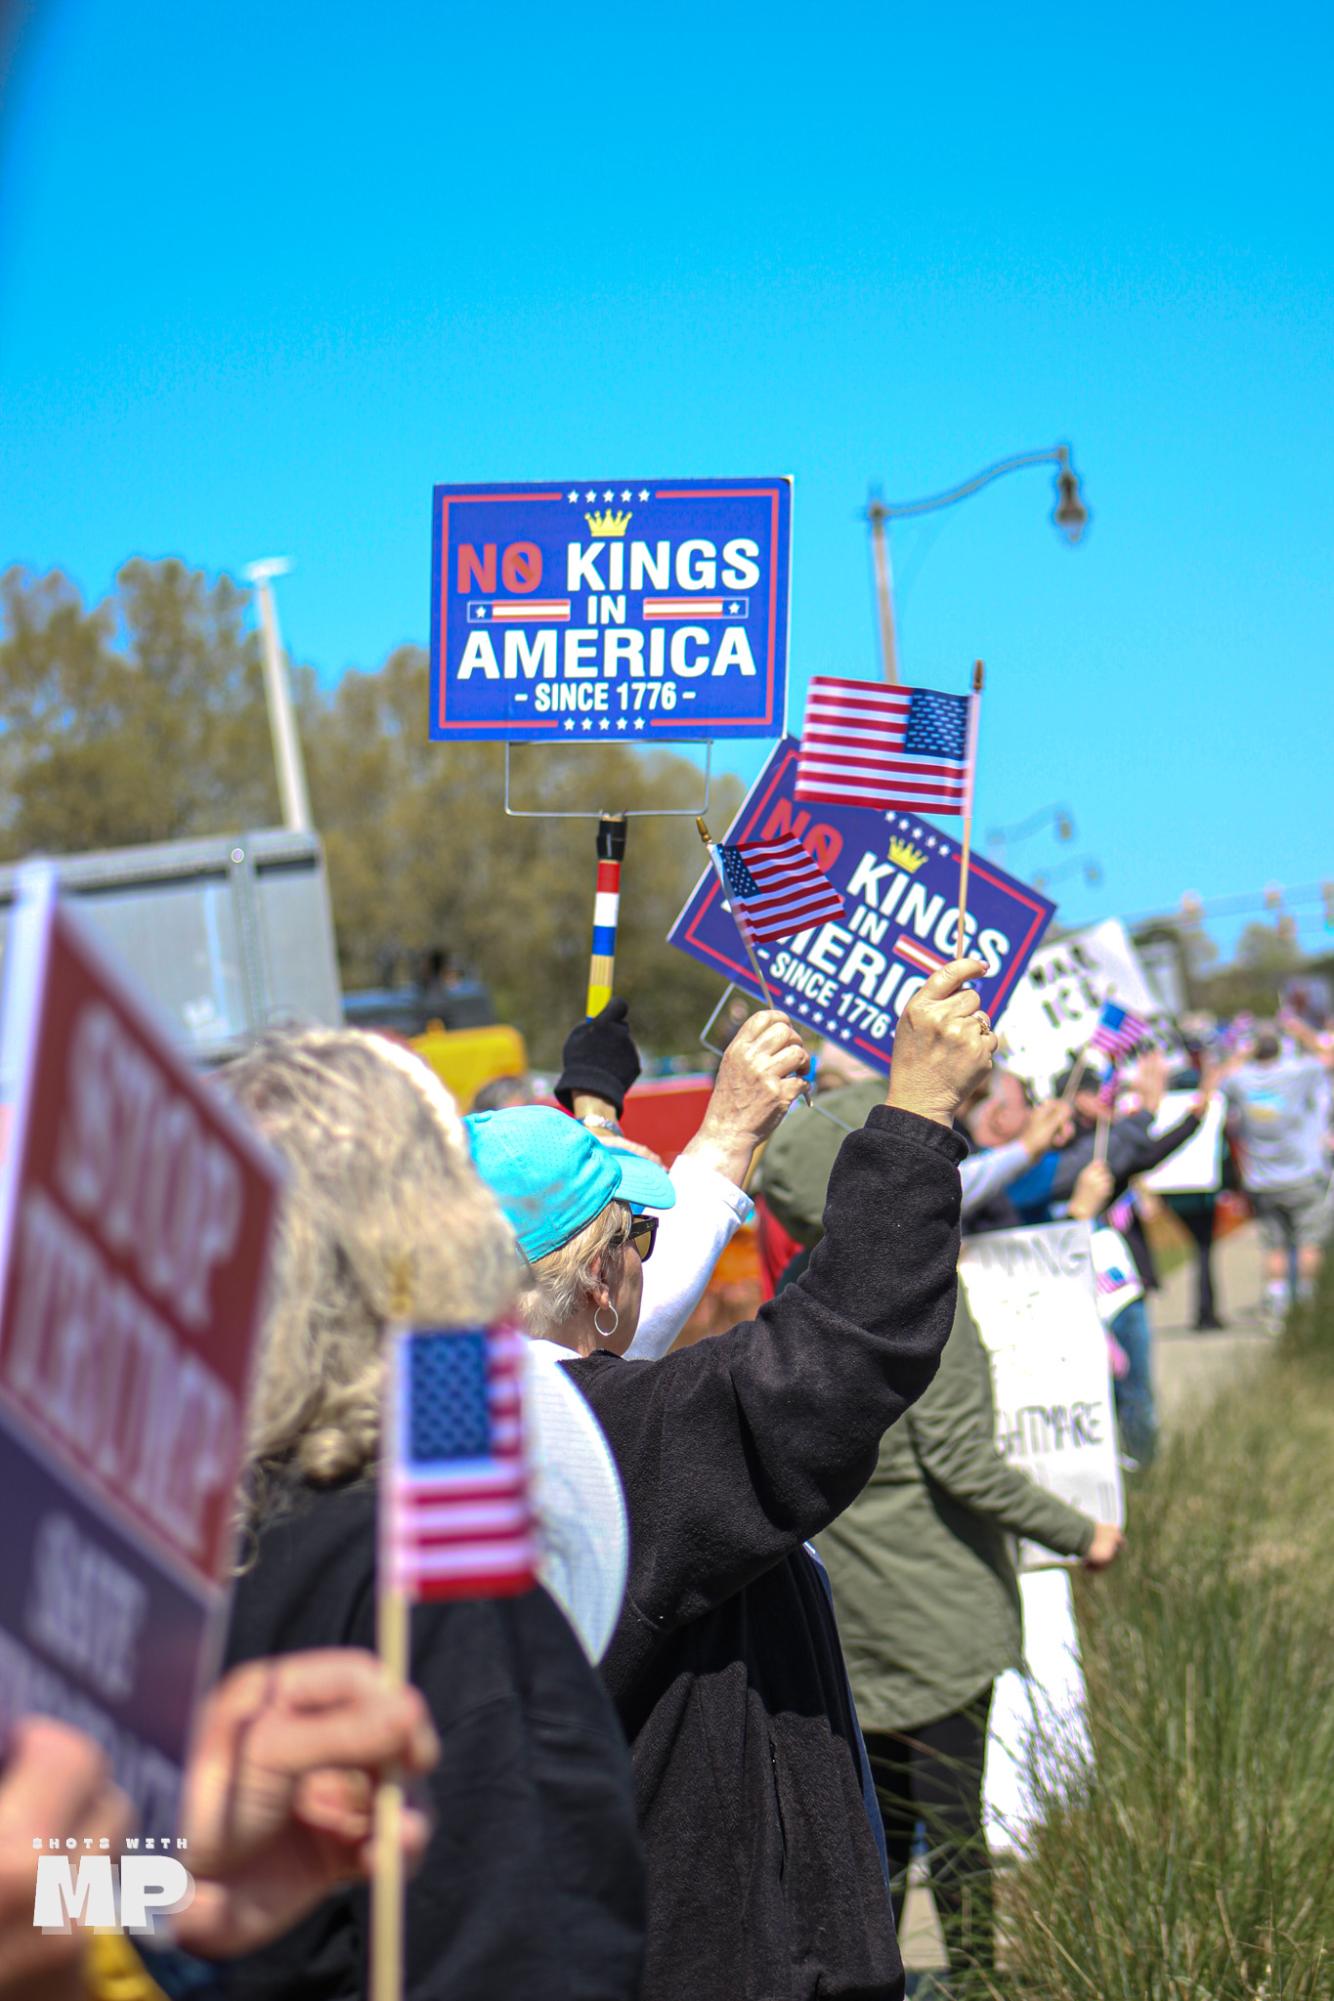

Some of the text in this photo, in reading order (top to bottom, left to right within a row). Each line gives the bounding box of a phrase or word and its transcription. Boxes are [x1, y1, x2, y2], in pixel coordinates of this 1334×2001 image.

[456, 538, 760, 594] NO KINGS
[587, 595, 626, 625] IN
[456, 626, 757, 680] AMERICA
[534, 682, 609, 712] SINCE
[616, 682, 677, 711] 1776
[846, 851, 1010, 978] KINGS
[848, 904, 890, 945] IN
[769, 951, 839, 1008] SINCE
[837, 992, 892, 1039] 1776
